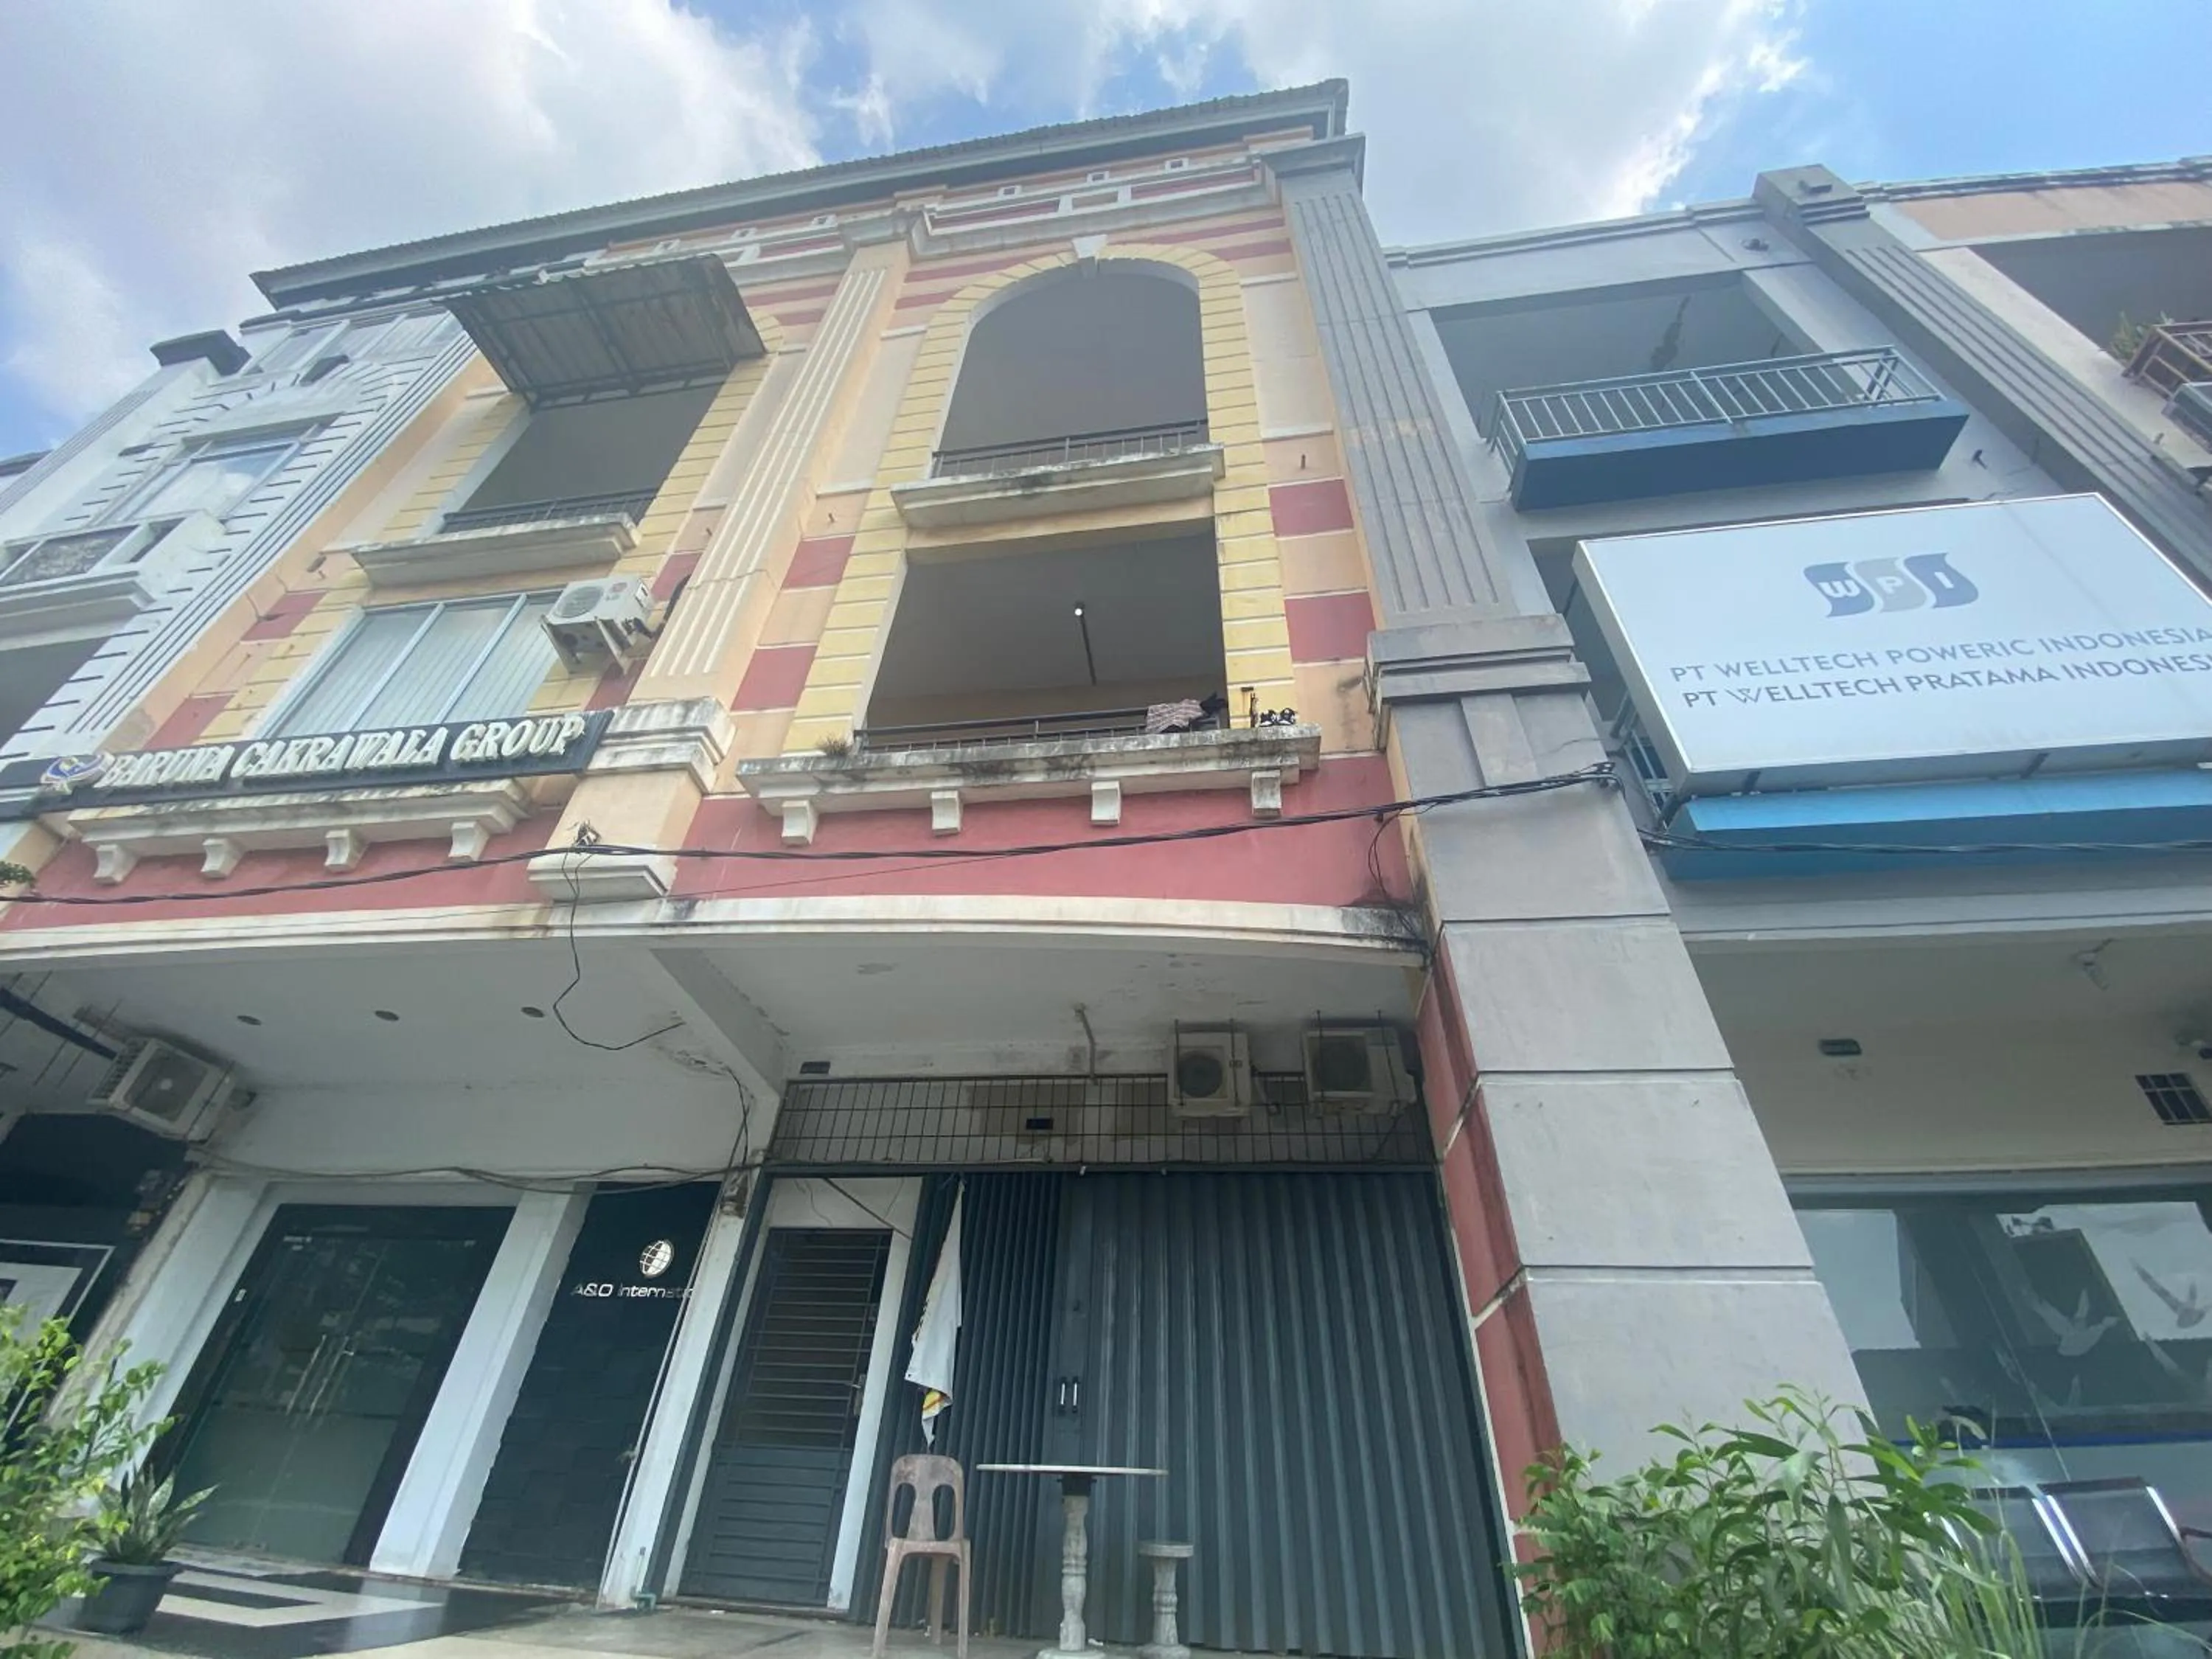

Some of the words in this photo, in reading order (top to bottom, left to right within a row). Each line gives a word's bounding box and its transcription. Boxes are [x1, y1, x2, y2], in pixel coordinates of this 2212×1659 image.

[1670, 665, 1704, 682] PT
[1713, 652, 1879, 678] WELLTECH
[1885, 639, 2035, 664] POWERIC
[2038, 627, 2212, 653] INDONESIA
[1682, 690, 1719, 708] PT
[1725, 677, 1902, 704] WELLTECH
[1905, 666, 2060, 692] PRATAMA
[96, 745, 234, 787] BARUNA
[231, 727, 448, 778] CAKRAWALA
[450, 717, 584, 761] GROUP
